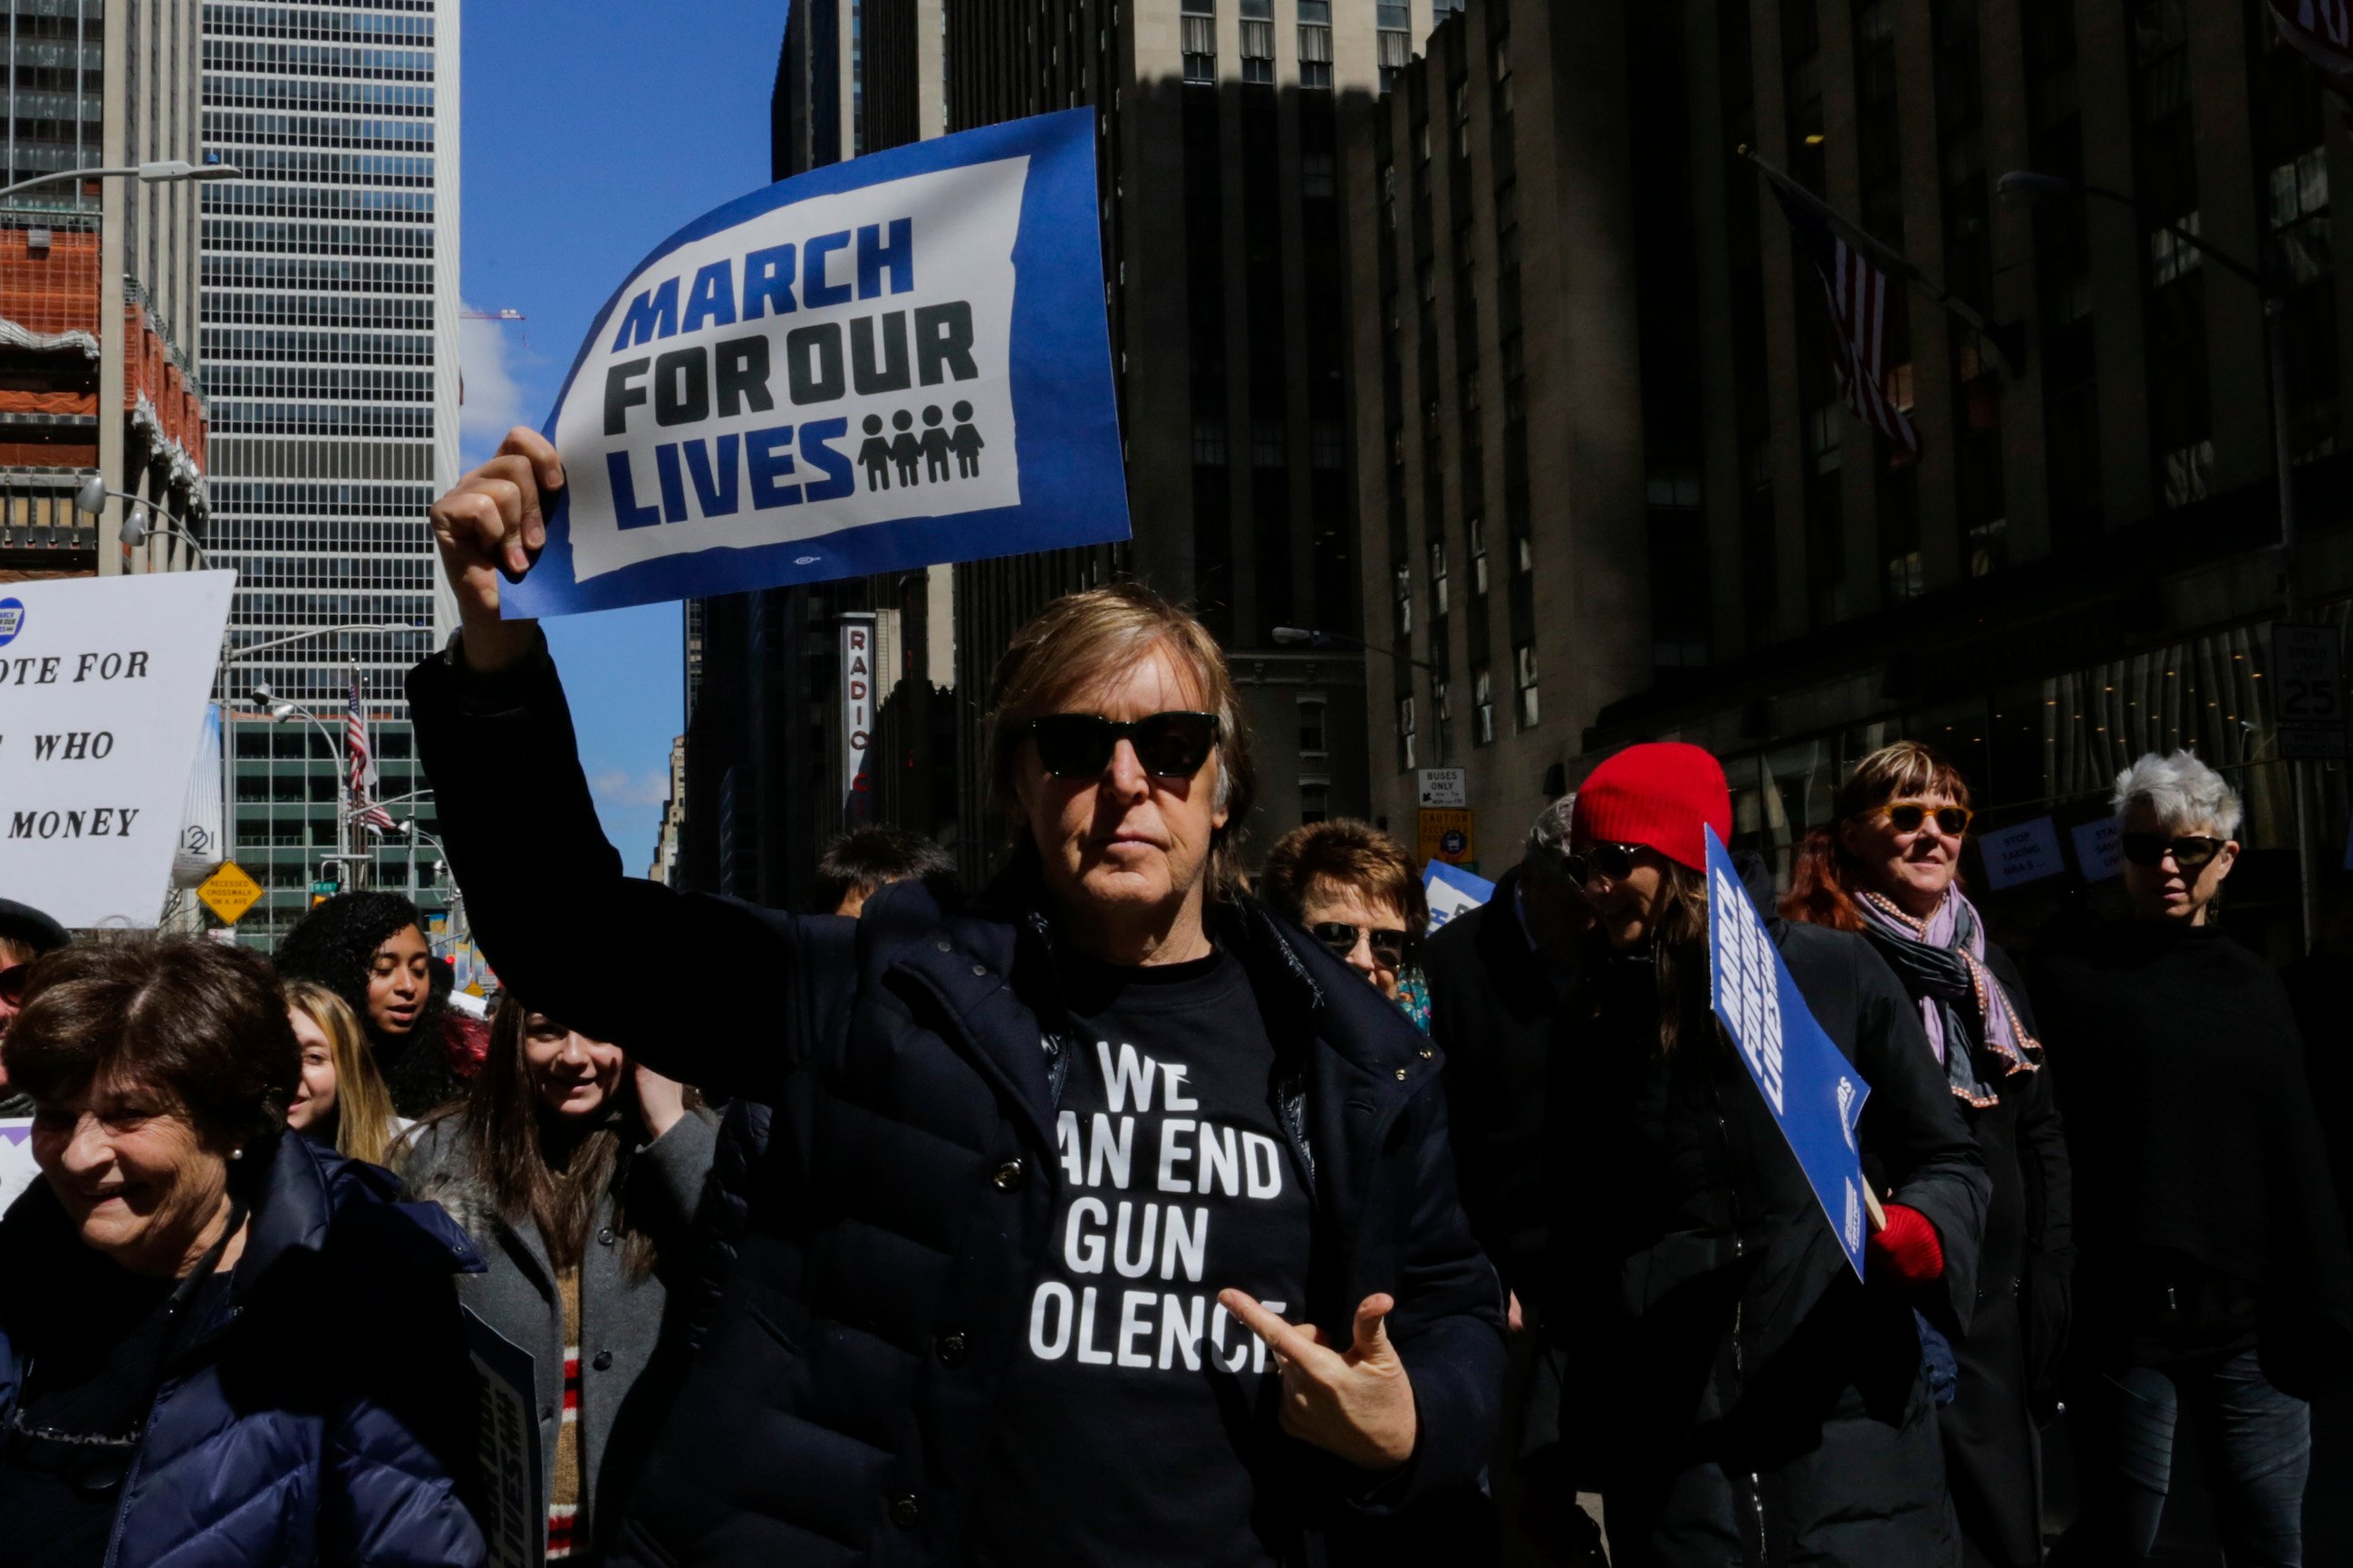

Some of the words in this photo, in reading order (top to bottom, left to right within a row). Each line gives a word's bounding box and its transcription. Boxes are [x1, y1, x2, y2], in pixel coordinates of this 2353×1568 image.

[611, 216, 914, 354] MARCH
[603, 334, 774, 437] FOR
[786, 300, 979, 406] OUR
[605, 416, 855, 532] LIVES
[72, 650, 149, 683] FOR
[850, 630, 870, 751] RADIO
[2285, 679, 2335, 716] 25
[34, 731, 114, 761] WHO
[1427, 771, 1457, 781] BUSES
[1422, 813, 1468, 823] CAUTION
[1431, 782, 1454, 790] ONLY
[8, 807, 140, 840] MONEY
[2001, 843, 2041, 861] TAKING
[2003, 831, 2030, 847] STOP
[209, 880, 250, 888] RECESSED
[1716, 867, 1741, 1041] MARCH
[1736, 885, 1760, 990] OUR
[1742, 968, 1763, 1078] FOR
[1762, 975, 1783, 1116] LIVES
[1097, 1041, 1199, 1113] WE
[1056, 1110, 1135, 1189] AN
[1157, 1118, 1283, 1199] END
[1064, 1196, 1210, 1283] GUN
